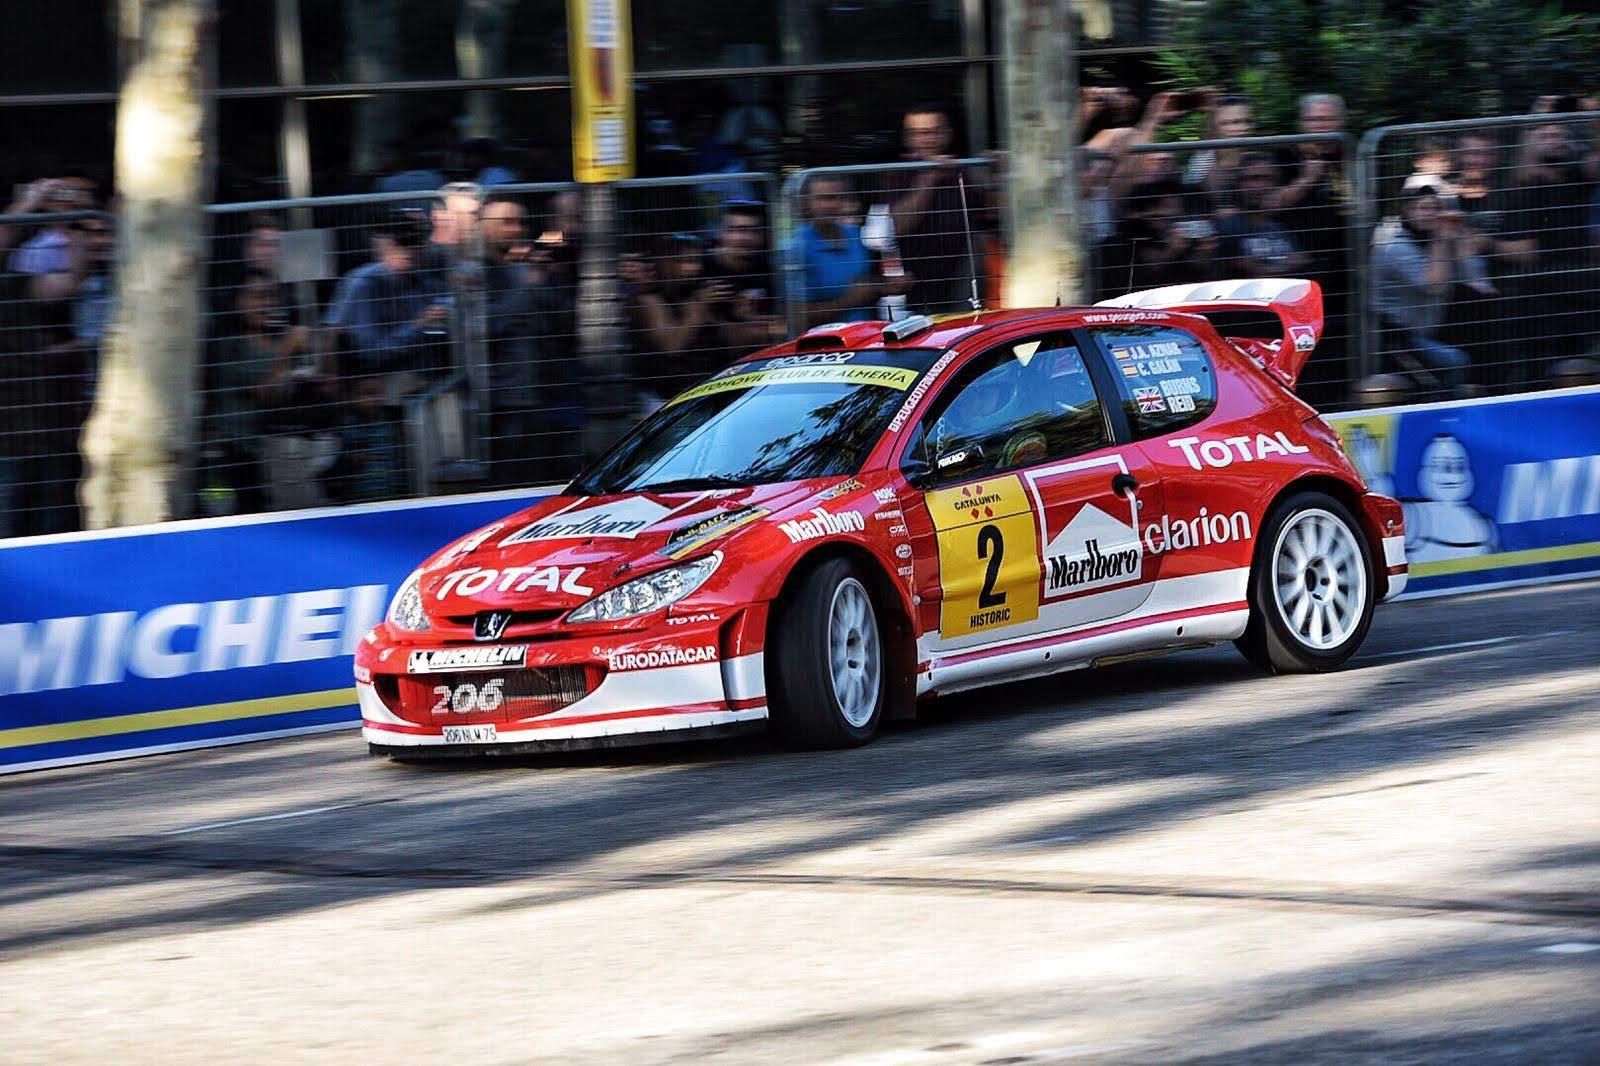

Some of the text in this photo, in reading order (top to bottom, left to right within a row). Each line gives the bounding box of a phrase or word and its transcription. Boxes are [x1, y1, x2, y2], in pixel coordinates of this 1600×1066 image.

[759, 351, 855, 372] sparco
[1167, 395, 1196, 414] REID
[1167, 431, 1310, 471] TOTAL
[954, 494, 1002, 510] CATALUNYA
[507, 513, 647, 542] Marlboro
[778, 507, 866, 543] Marlboro
[1144, 506, 1252, 555] clarion
[977, 524, 1007, 609] 2
[1048, 539, 1139, 590] Marlboro
[436, 566, 595, 601] TOTAL
[666, 613, 720, 626] TOTAL
[970, 607, 1011, 628] HISTORIC
[428, 645, 525, 665] MICHELIN
[607, 645, 719, 671] EURODATACAR
[431, 678, 505, 716] 206
